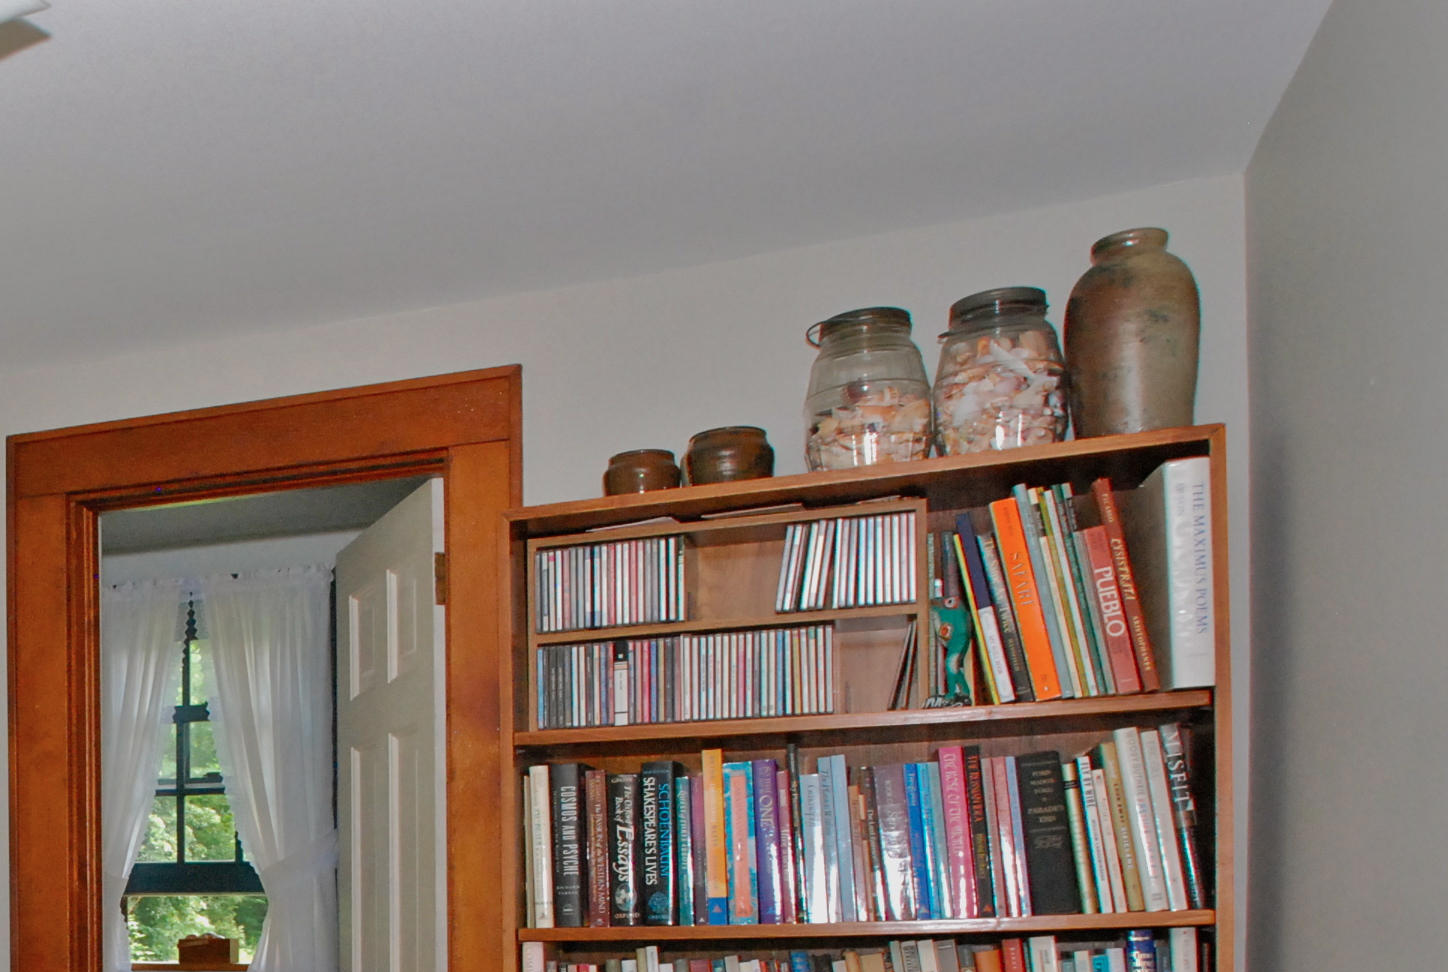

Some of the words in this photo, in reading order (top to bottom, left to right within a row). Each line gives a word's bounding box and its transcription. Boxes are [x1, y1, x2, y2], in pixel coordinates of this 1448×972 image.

[1193, 483, 1206, 512] THE
[1194, 515, 1207, 582] MAXIMUS
[1093, 567, 1126, 638] PUEBLO
[1196, 588, 1209, 636] POEMS
[560, 785, 578, 822] COSMOS
[642, 777, 657, 854] SHAKESPEARE'S
[1086, 790, 1096, 809] WIRE
[561, 825, 575, 841] AND
[658, 784, 671, 877] SCHOENBAUM
[562, 844, 580, 877] PSYCHE
[612, 825, 636, 882] Essays
[645, 856, 658, 885] LIVES
